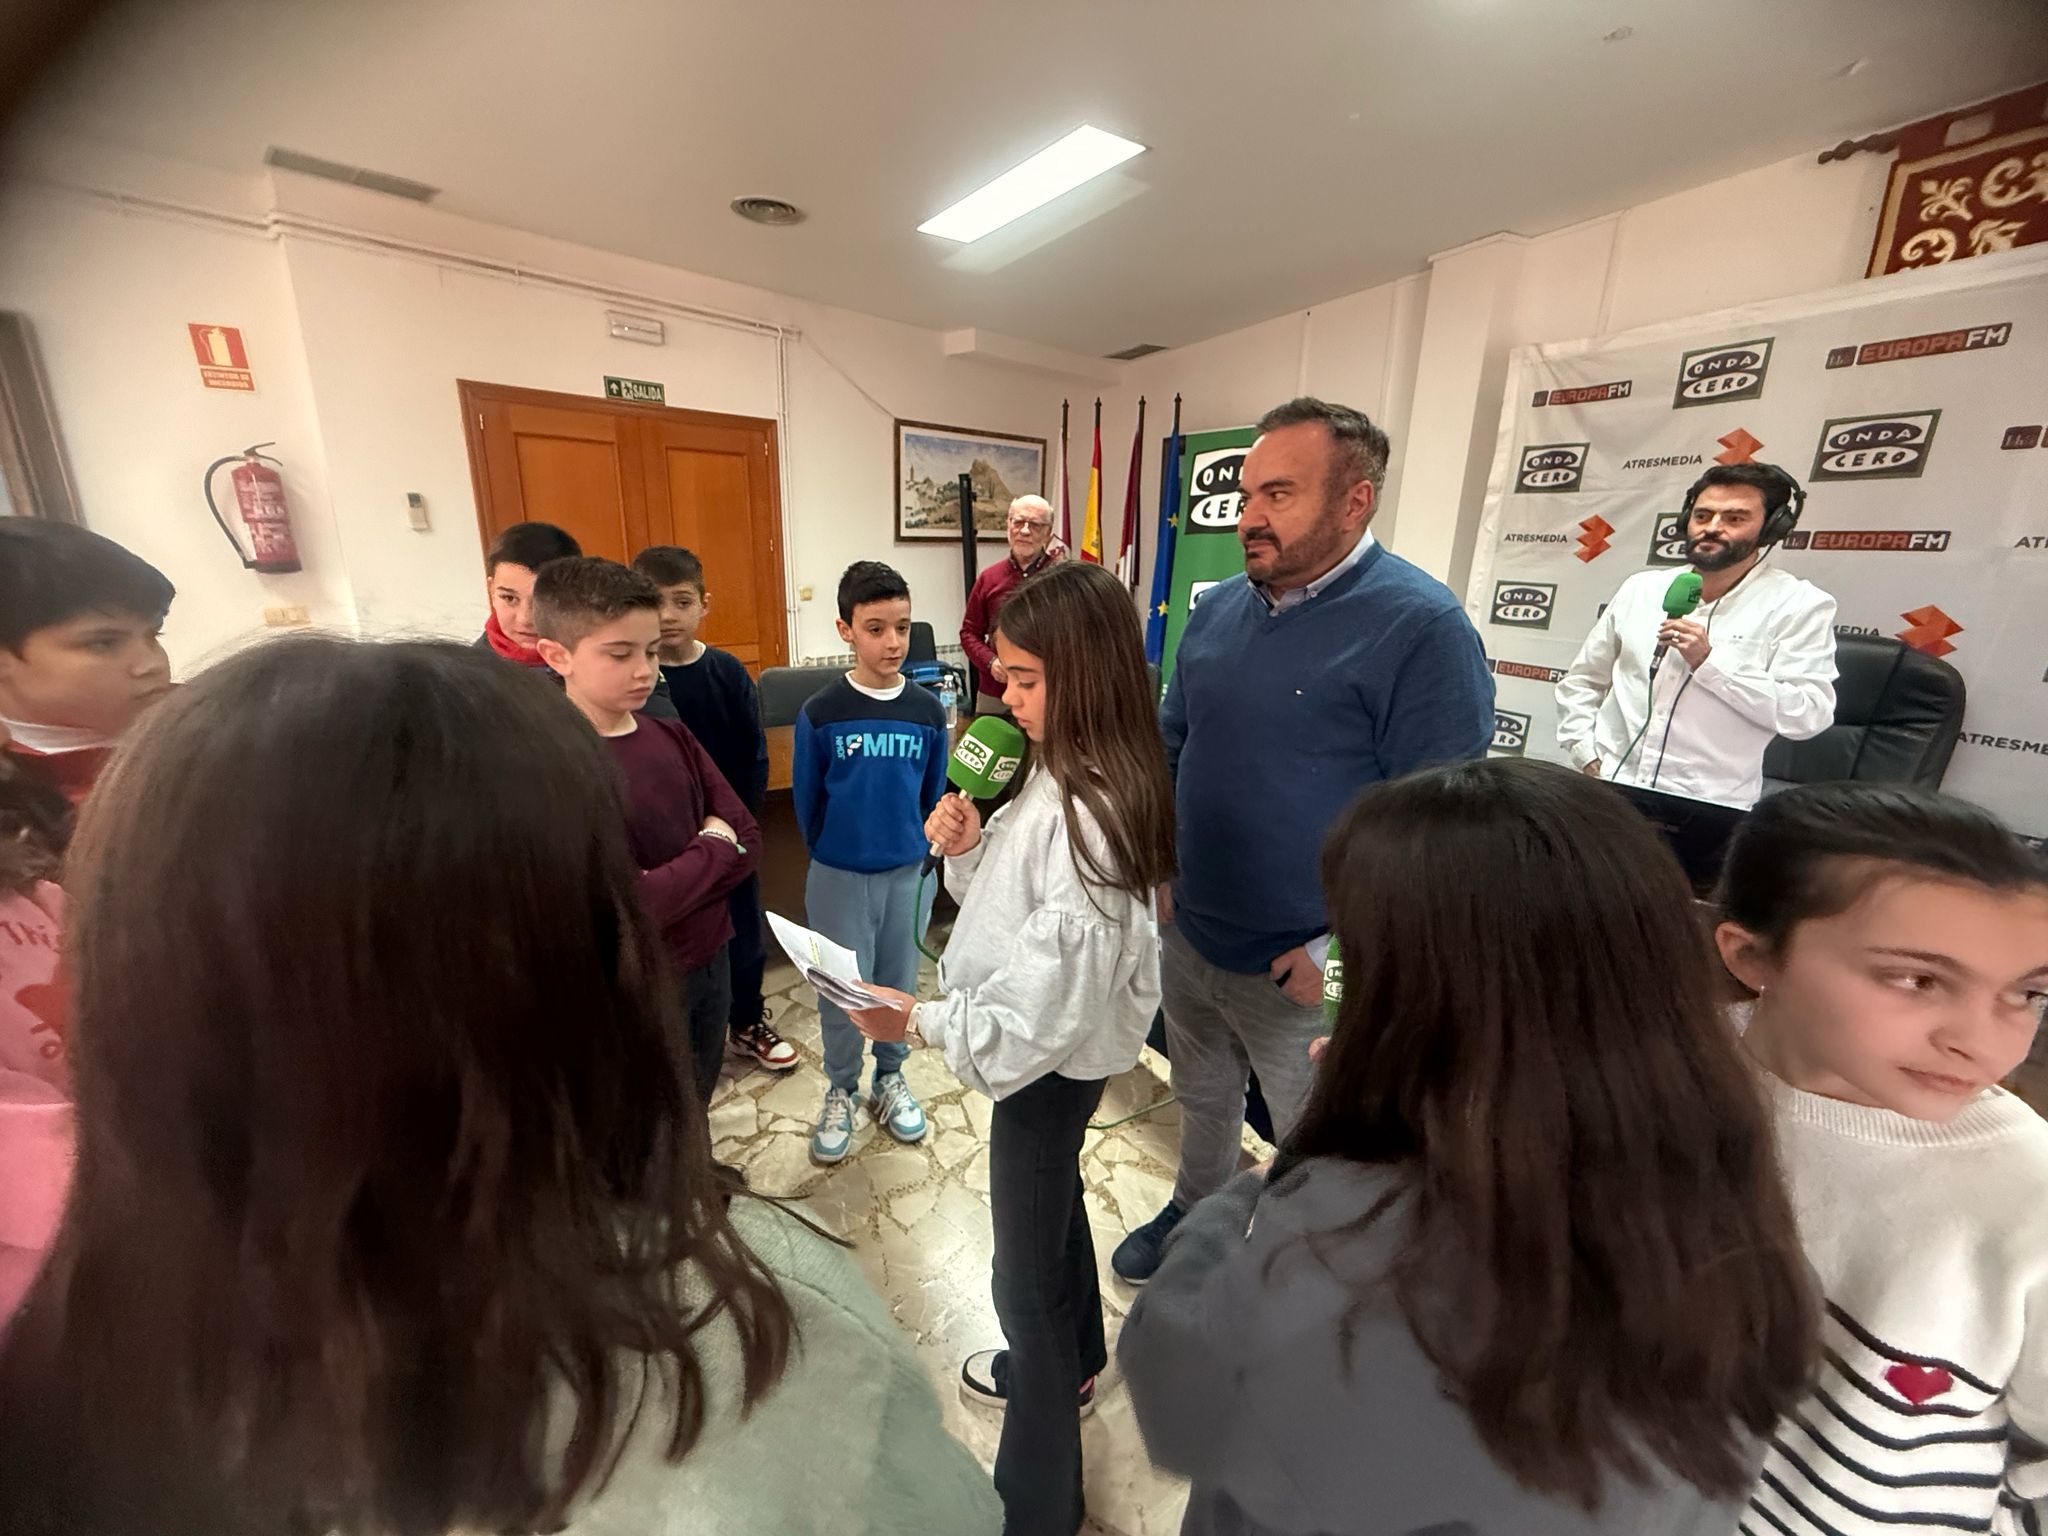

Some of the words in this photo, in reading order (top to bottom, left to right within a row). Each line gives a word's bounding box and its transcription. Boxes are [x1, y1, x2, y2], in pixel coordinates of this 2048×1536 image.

[1694, 354, 1752, 375] ONDA
[632, 383, 663, 401] SALIDA
[1693, 376, 1749, 395] CERO
[1837, 428, 1911, 446] ONDA
[1532, 454, 1573, 466] ONDA
[1622, 454, 1703, 470] ATRESMEDIA
[1835, 451, 1906, 468] CERO
[1530, 471, 1570, 483] CERO
[1504, 533, 1568, 544] ATRESMEDIA
[1503, 592, 1544, 602] ONDA
[1503, 607, 1539, 619] CERO
[963, 740, 987, 758] ONDA
[960, 750, 980, 766] CERO
